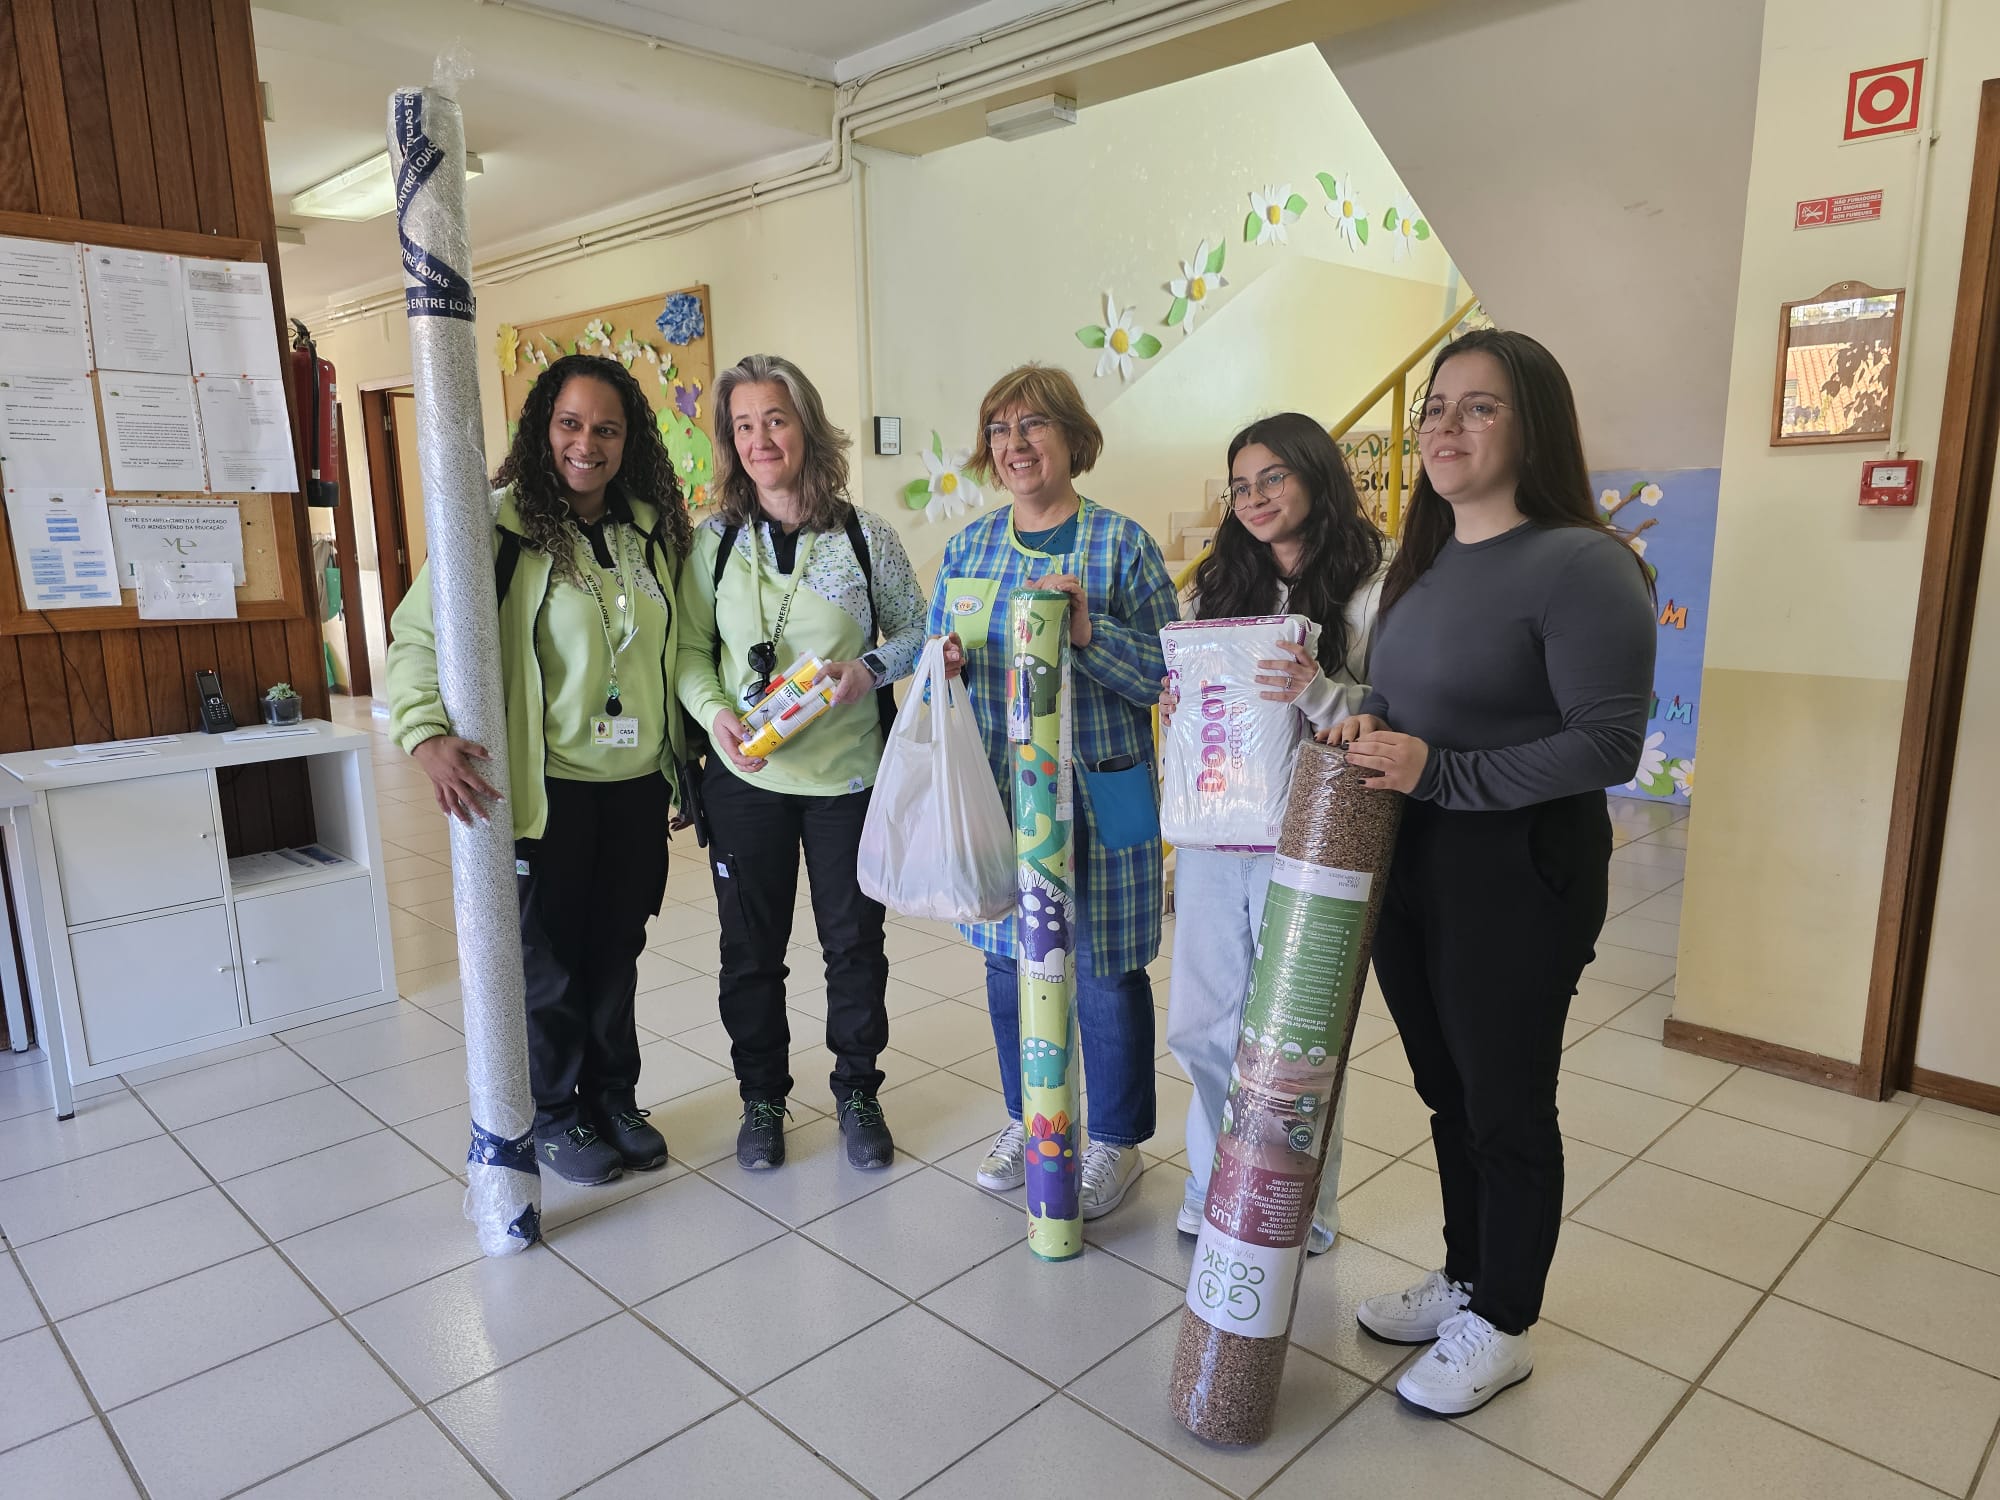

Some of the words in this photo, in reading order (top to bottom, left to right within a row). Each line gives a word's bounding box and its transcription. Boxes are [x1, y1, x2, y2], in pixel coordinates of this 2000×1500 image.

[397, 169, 419, 209] ENTRE
[411, 140, 439, 173] LOJAS
[416, 260, 450, 288] LOJAS
[411, 297, 446, 309] ENTRE
[449, 299, 476, 315] LOJAS
[586, 574, 604, 604] MERLIN
[600, 604, 611, 629] LEROY
[777, 593, 790, 623] MERLIN
[773, 623, 782, 646] EROY
[1196, 680, 1228, 793] DODOT
[1211, 1204, 1240, 1231] PLUS
[1261, 1209, 1286, 1217] AISLANTE
[1200, 1243, 1265, 1285] CORK
